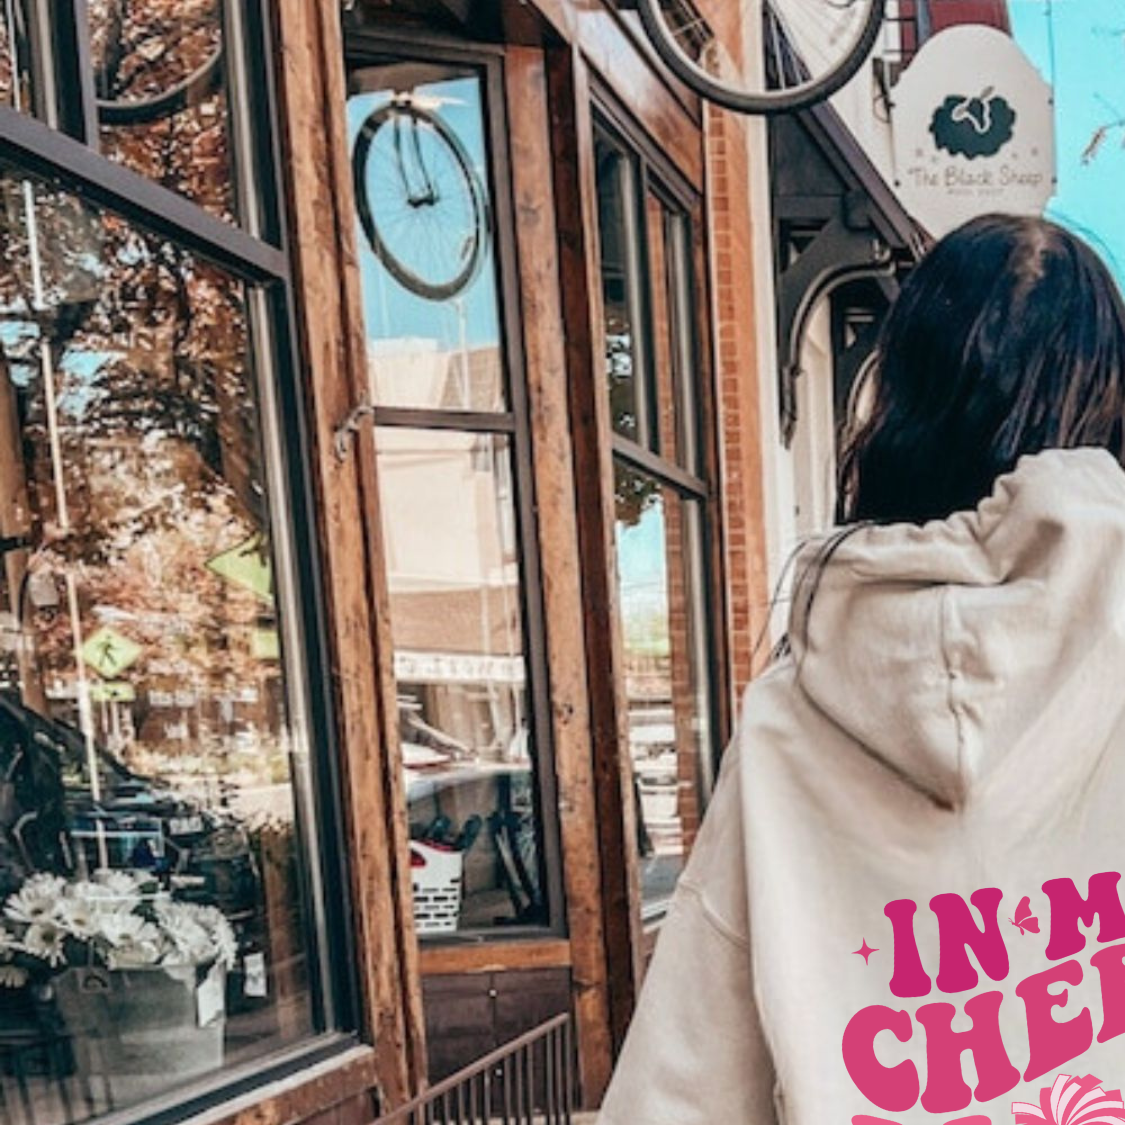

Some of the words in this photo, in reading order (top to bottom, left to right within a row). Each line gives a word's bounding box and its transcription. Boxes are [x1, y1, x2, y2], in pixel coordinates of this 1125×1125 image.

[907, 167, 938, 186] The
[945, 165, 991, 187] Black
[999, 164, 1043, 188] Sheep
[884, 888, 1009, 998] IN
